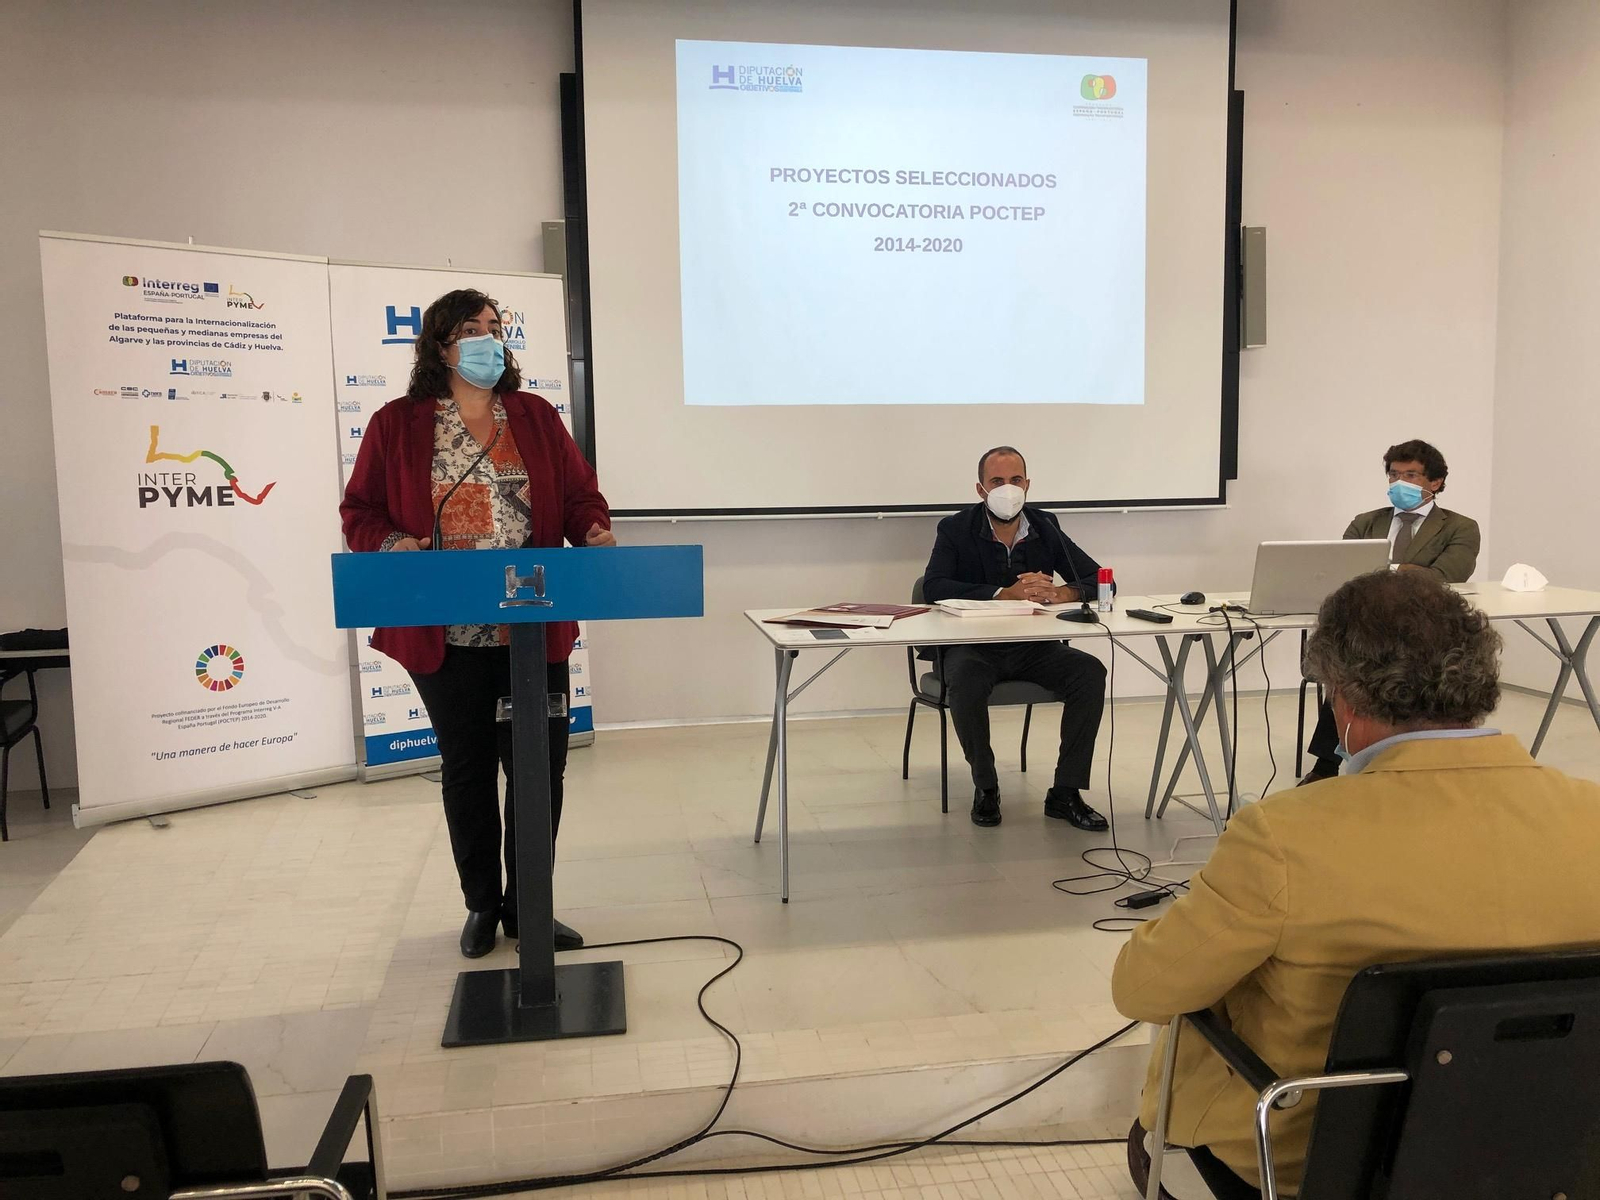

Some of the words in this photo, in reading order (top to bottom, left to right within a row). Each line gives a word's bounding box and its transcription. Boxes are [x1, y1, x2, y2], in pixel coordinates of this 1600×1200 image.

[739, 64, 803, 76] DIPUTACIÓN
[739, 76, 753, 84] DE
[758, 76, 802, 86] HUELVA
[769, 167, 890, 184] PROYECTOS
[895, 170, 1057, 189] SELECCIONADOS
[788, 201, 807, 217] 2ª
[812, 202, 965, 219] CONVOCATORIA
[969, 205, 1046, 221] POCTEP
[873, 236, 963, 253] 2014-2020
[143, 277, 199, 293] Interreg
[227, 301, 253, 310] PYME
[114, 312, 163, 322] Plataforma
[196, 318, 276, 329] Internacionalización
[137, 327, 180, 335] pequeñas
[188, 329, 228, 337] medianas
[230, 332, 269, 341] empresas
[109, 336, 144, 344] Algarve
[166, 339, 210, 348] provincias
[224, 341, 246, 349] Cádiz
[138, 472, 196, 486] INTER
[138, 486, 235, 508] PYME
[162, 717, 184, 725] Regional
[178, 746, 216, 758] manera
[219, 742, 230, 752] de
[233, 739, 260, 750] hacer
[262, 732, 298, 746] Europa"
[390, 736, 438, 751] diphuelv
